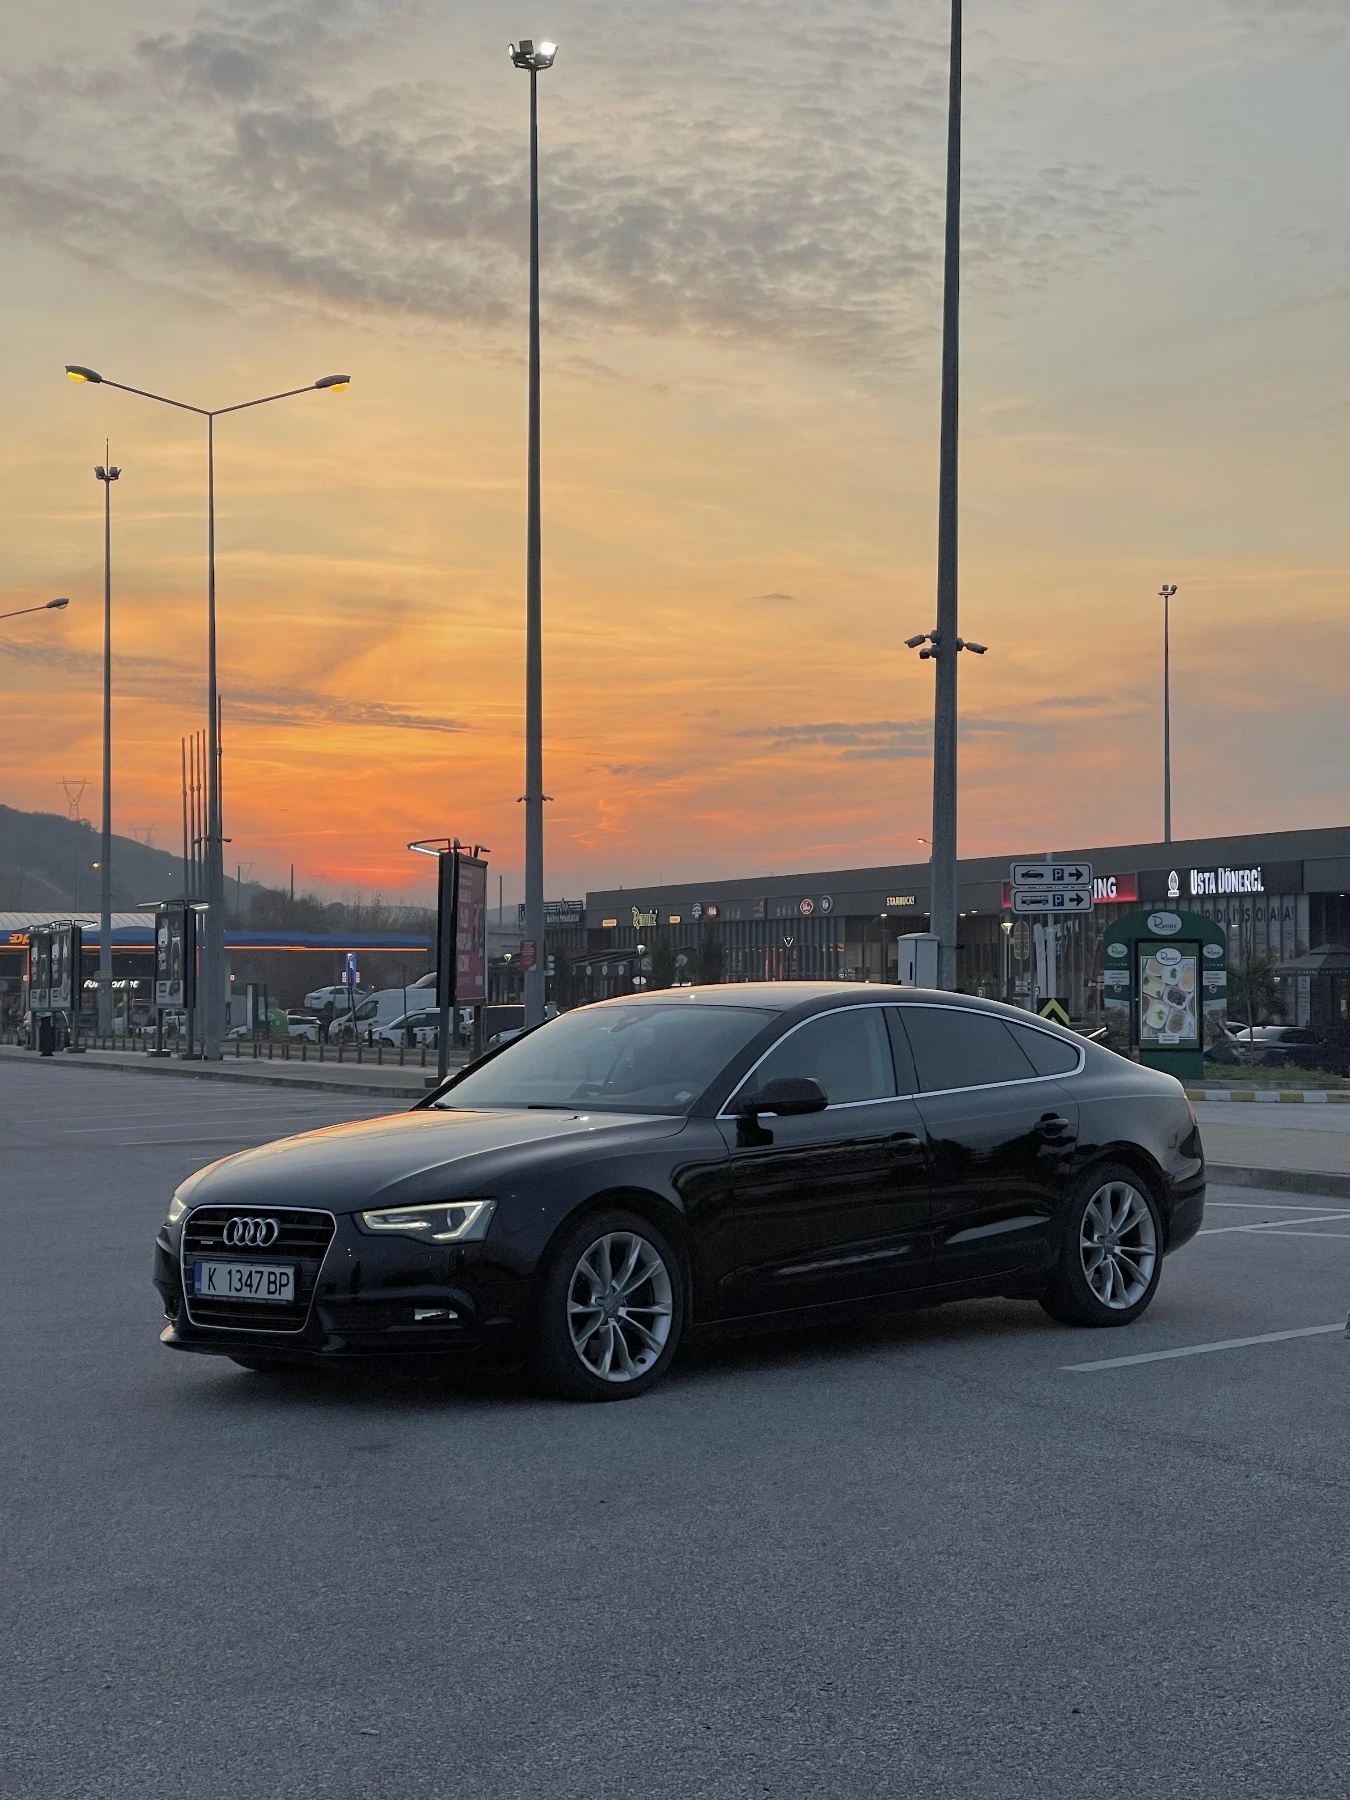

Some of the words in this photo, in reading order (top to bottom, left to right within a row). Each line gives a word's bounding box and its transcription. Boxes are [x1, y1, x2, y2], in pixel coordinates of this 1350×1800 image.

[1054, 869, 1062, 880] P
[1093, 876, 1117, 899] ING
[886, 895, 915, 906] STARBUCKS
[1054, 895, 1062, 906] P
[1151, 915, 1177, 930] Ramiz
[207, 1267, 217, 1291] K
